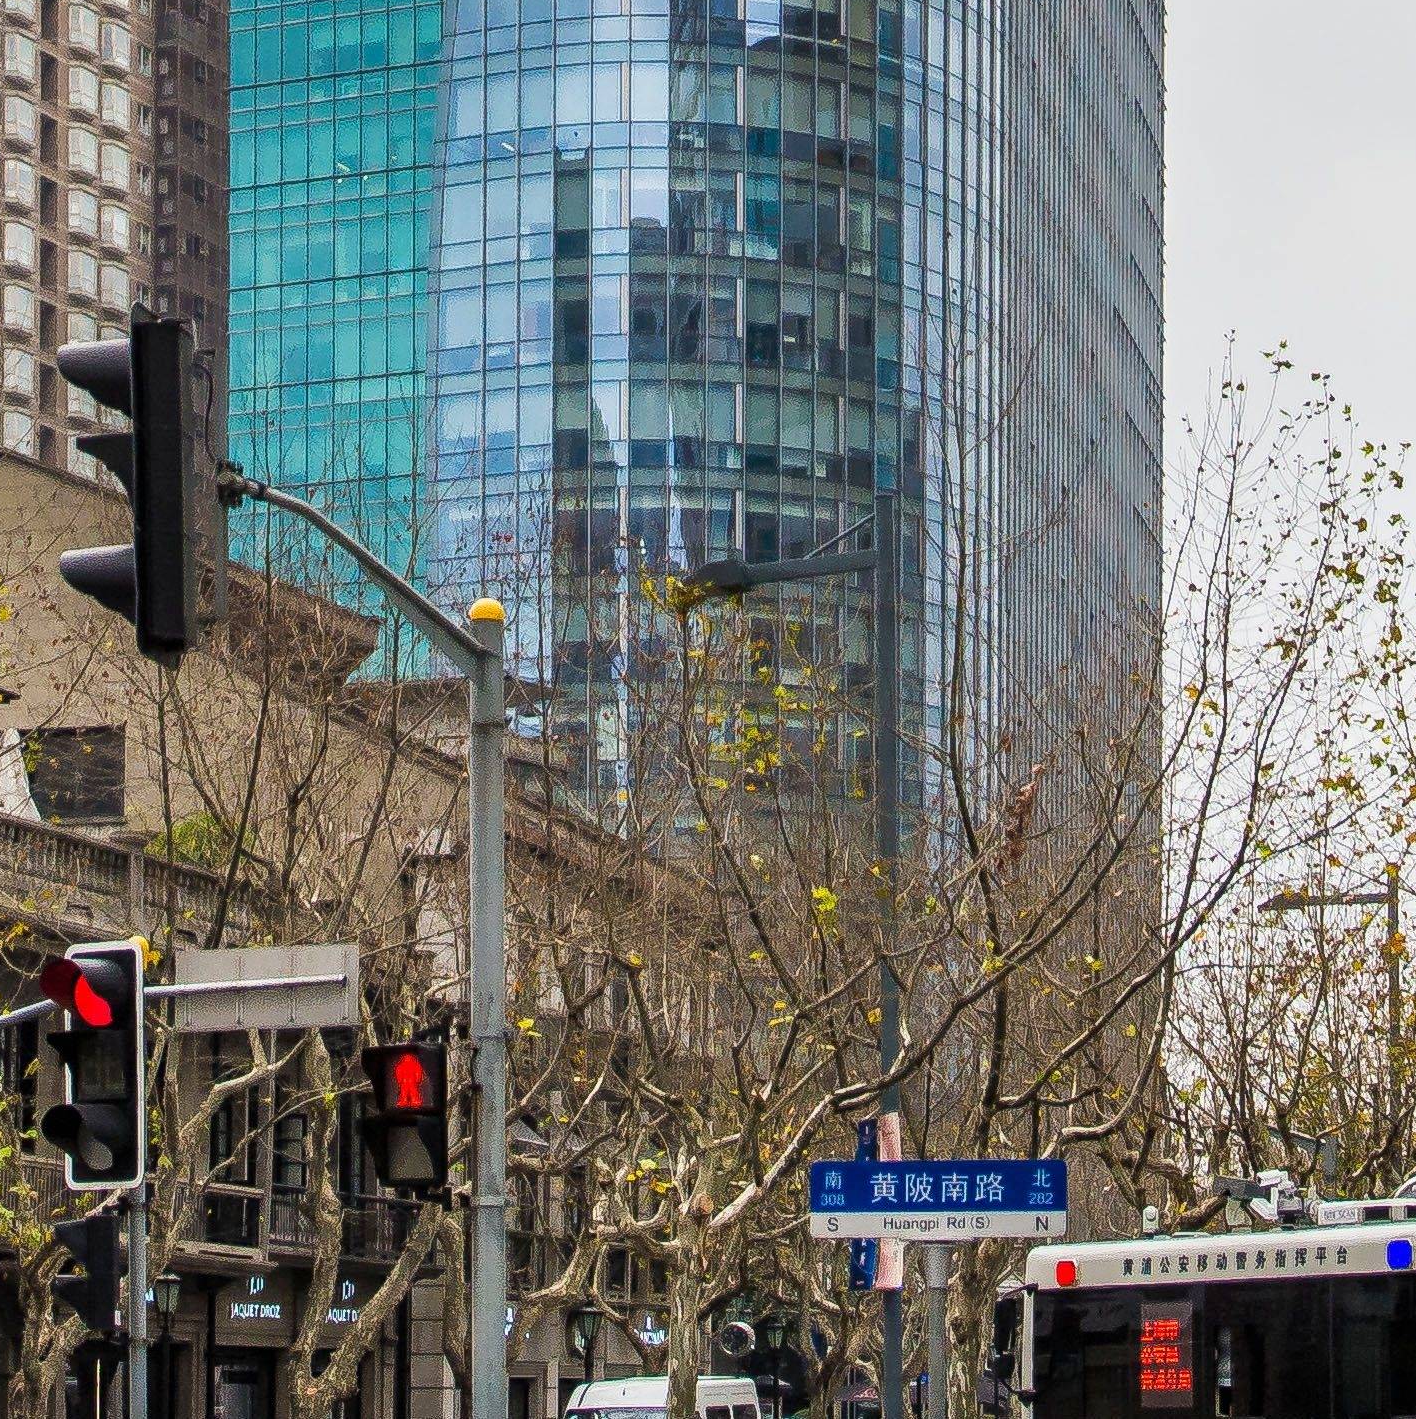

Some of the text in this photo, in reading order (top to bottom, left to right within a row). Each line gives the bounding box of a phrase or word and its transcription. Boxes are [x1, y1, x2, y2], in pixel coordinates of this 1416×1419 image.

[824, 1170, 843, 1191] 南
[1032, 1168, 1052, 1189] 北
[869, 1171, 1006, 1204] 黄陂南路
[1028, 1192, 1054, 1205] 282
[826, 1217, 840, 1232] S
[883, 1216, 940, 1233] Huangpi
[1035, 1215, 1050, 1232] N
[1121, 1245, 1349, 1277] 黄浦公安移动警务指挥平台
[230, 1303, 282, 1320] JAQUET DROZ
